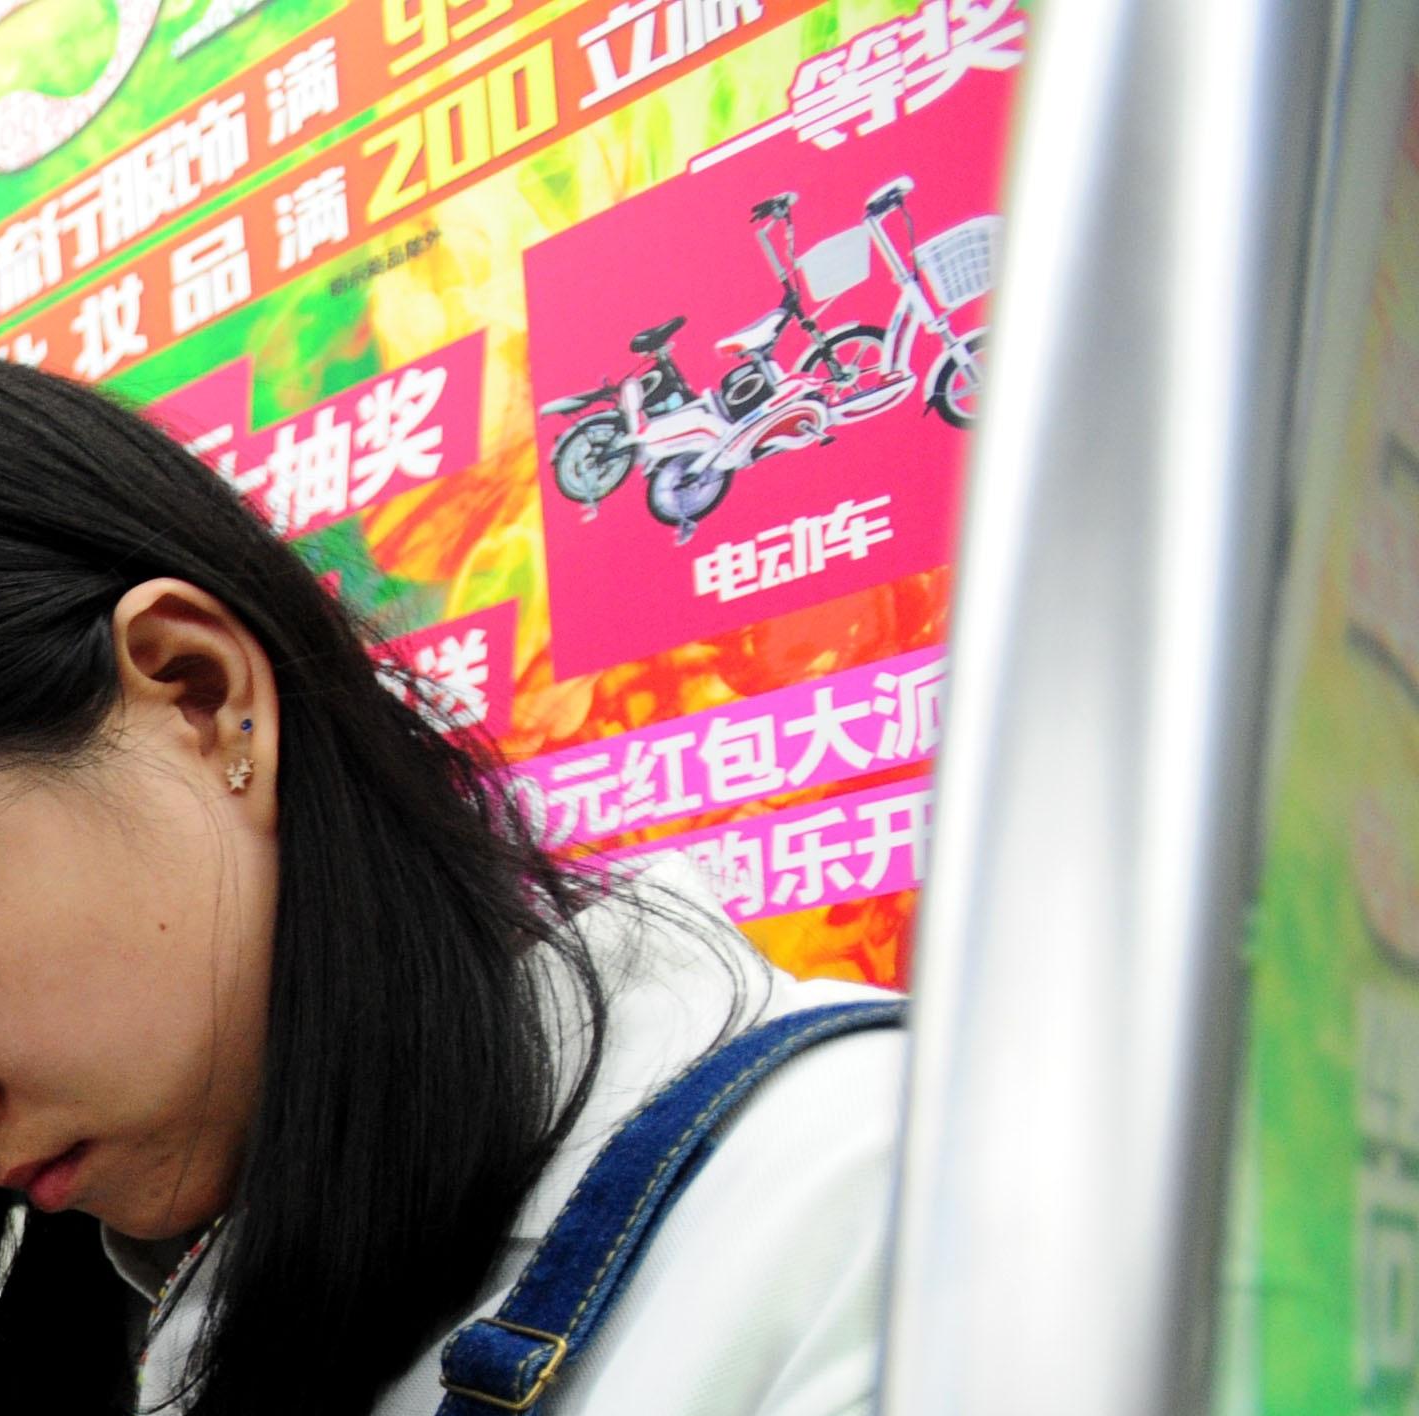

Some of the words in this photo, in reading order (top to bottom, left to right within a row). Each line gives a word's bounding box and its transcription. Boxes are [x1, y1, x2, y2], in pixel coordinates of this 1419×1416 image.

[362, 38, 559, 225] 200
[690, 0, 1026, 173] 一等奖
[694, 494, 894, 603] 电动车
